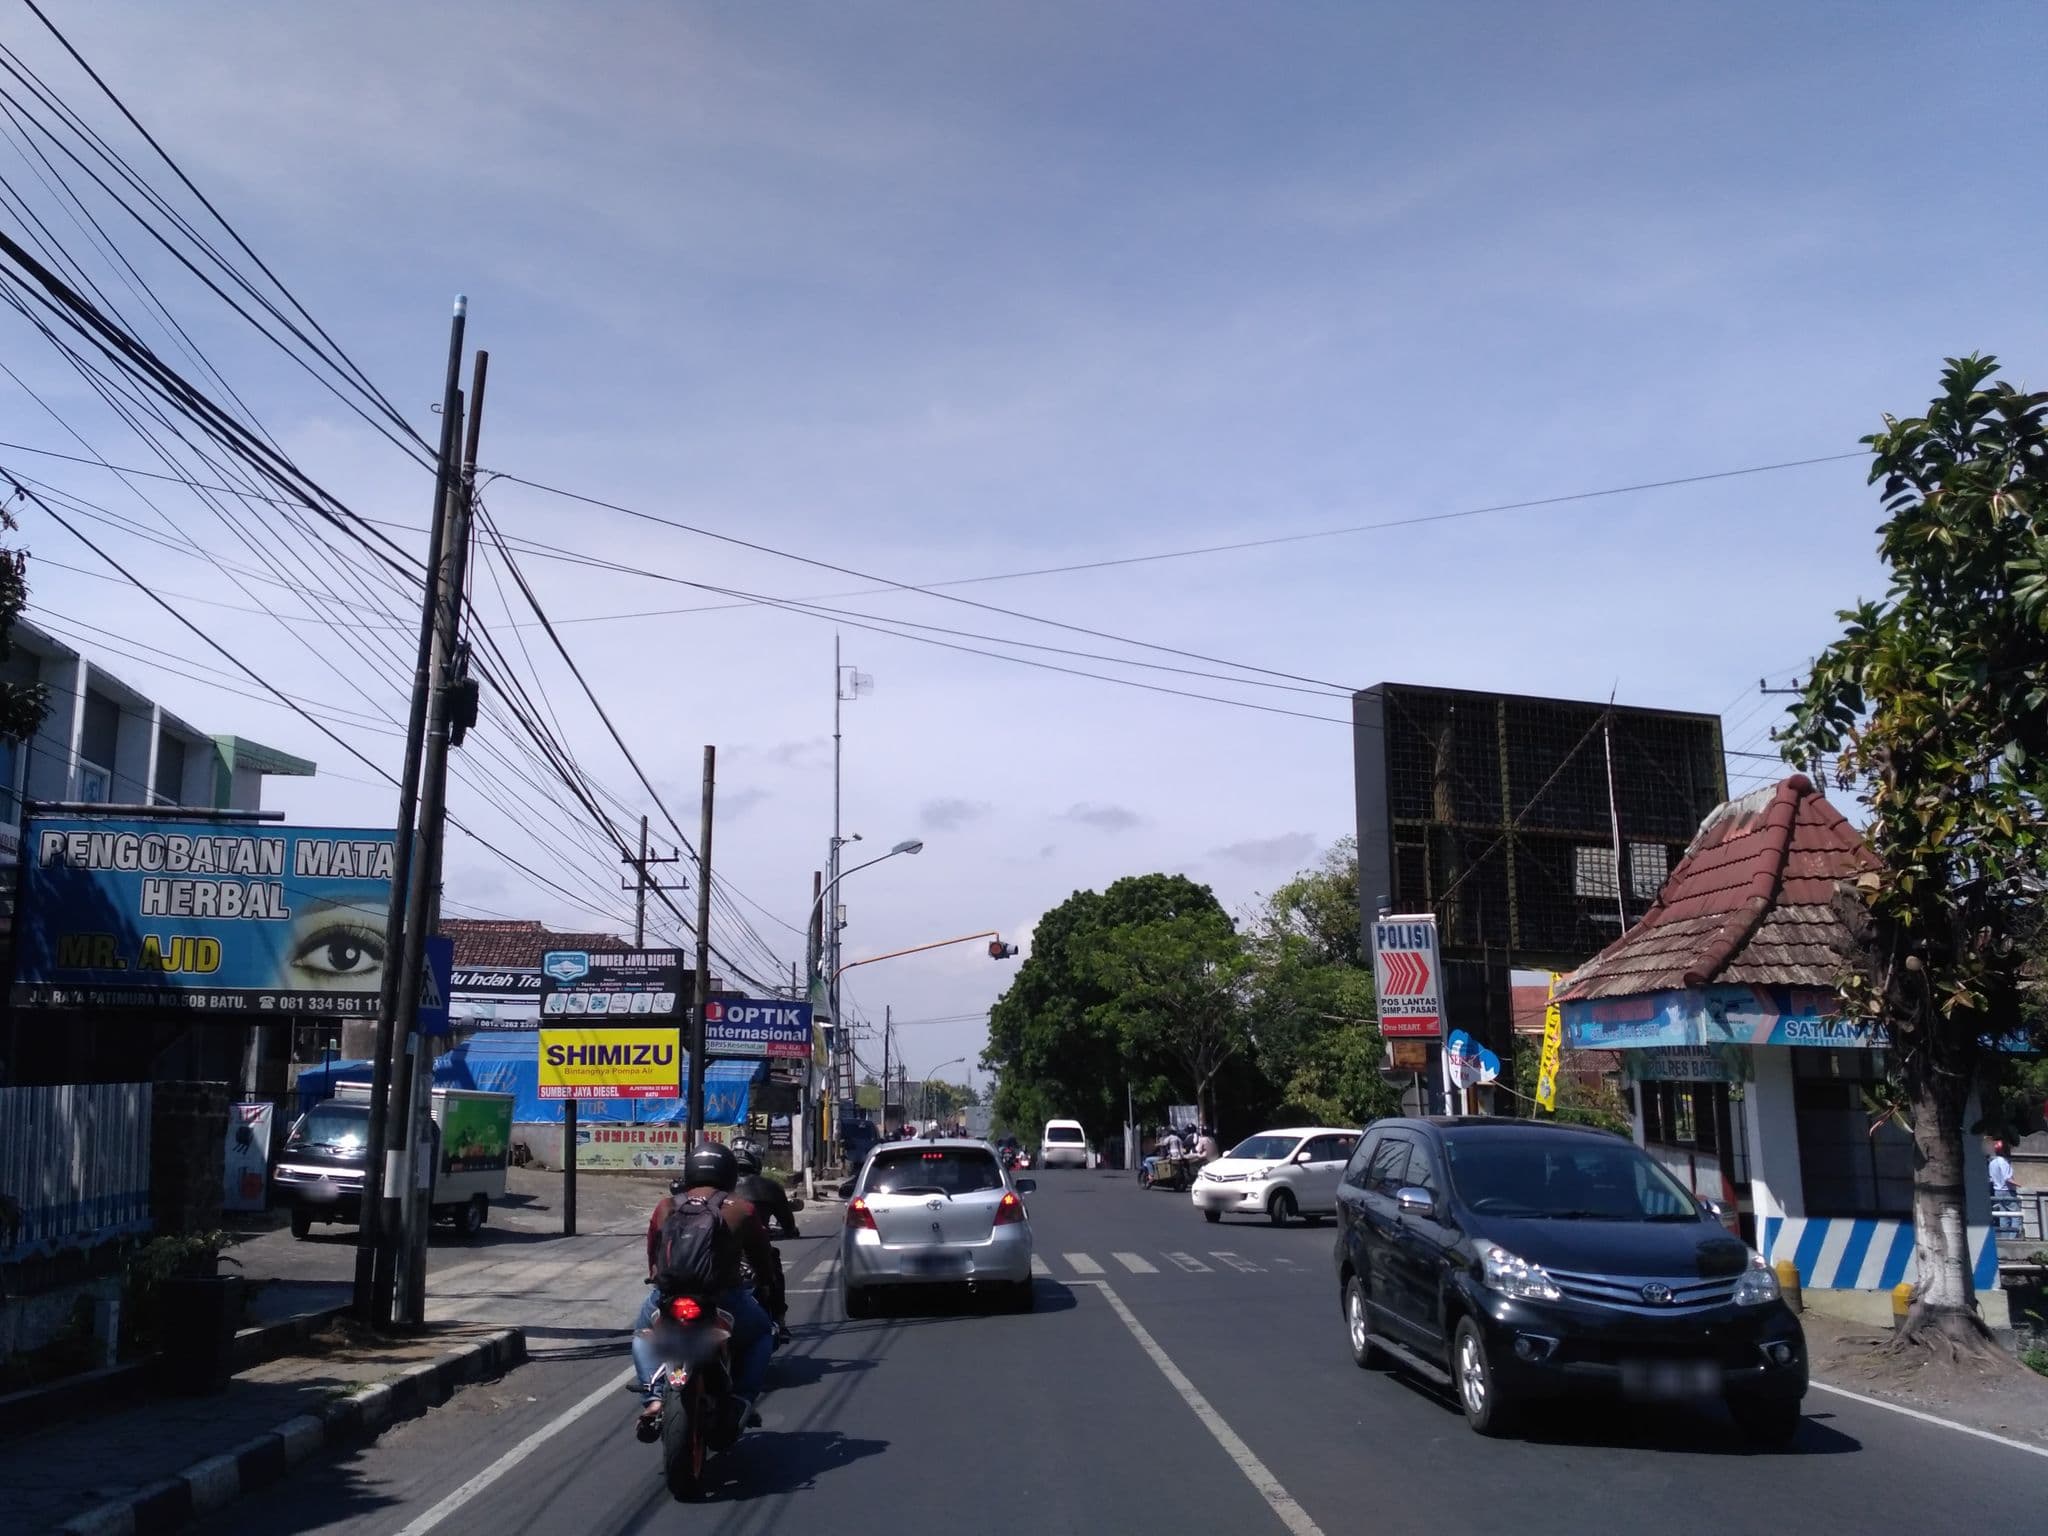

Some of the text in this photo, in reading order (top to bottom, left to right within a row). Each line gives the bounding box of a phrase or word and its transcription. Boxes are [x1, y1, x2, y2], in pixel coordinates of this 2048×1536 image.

[39, 832, 287, 876] PENGOBATAN
[295, 839, 394, 879] MATA
[140, 879, 290, 920] HERBAL
[1376, 925, 1431, 949] POLISI
[57, 933, 223, 973] MR. AJID
[589, 954, 677, 967] SUMBER JAYA DIESEL
[467, 973, 513, 987] Indah
[52, 991, 84, 1004] RAYA
[90, 993, 154, 1007] PATIMURA
[210, 995, 247, 1009] BATU.
[279, 997, 304, 1009] 081
[308, 997, 333, 1010] 334
[337, 998, 360, 1011] 561
[1381, 998, 1437, 1006] POS LANTAS
[1382, 1006, 1409, 1014] SIMP.3
[727, 1006, 800, 1025] OPTIK
[705, 1023, 807, 1042] Internasional
[710, 1041, 727, 1049] BPJS
[546, 1044, 673, 1067] SHIMIZU
[564, 1067, 610, 1076] Bintangnya
[612, 1067, 640, 1075] Pompa
[1650, 1059, 1725, 1078] POLRES BATU
[540, 1086, 619, 1098] SUMBER JAYA DIESEL
[594, 1130, 646, 1143] SUMBER
[650, 1131, 678, 1143] JAYA
